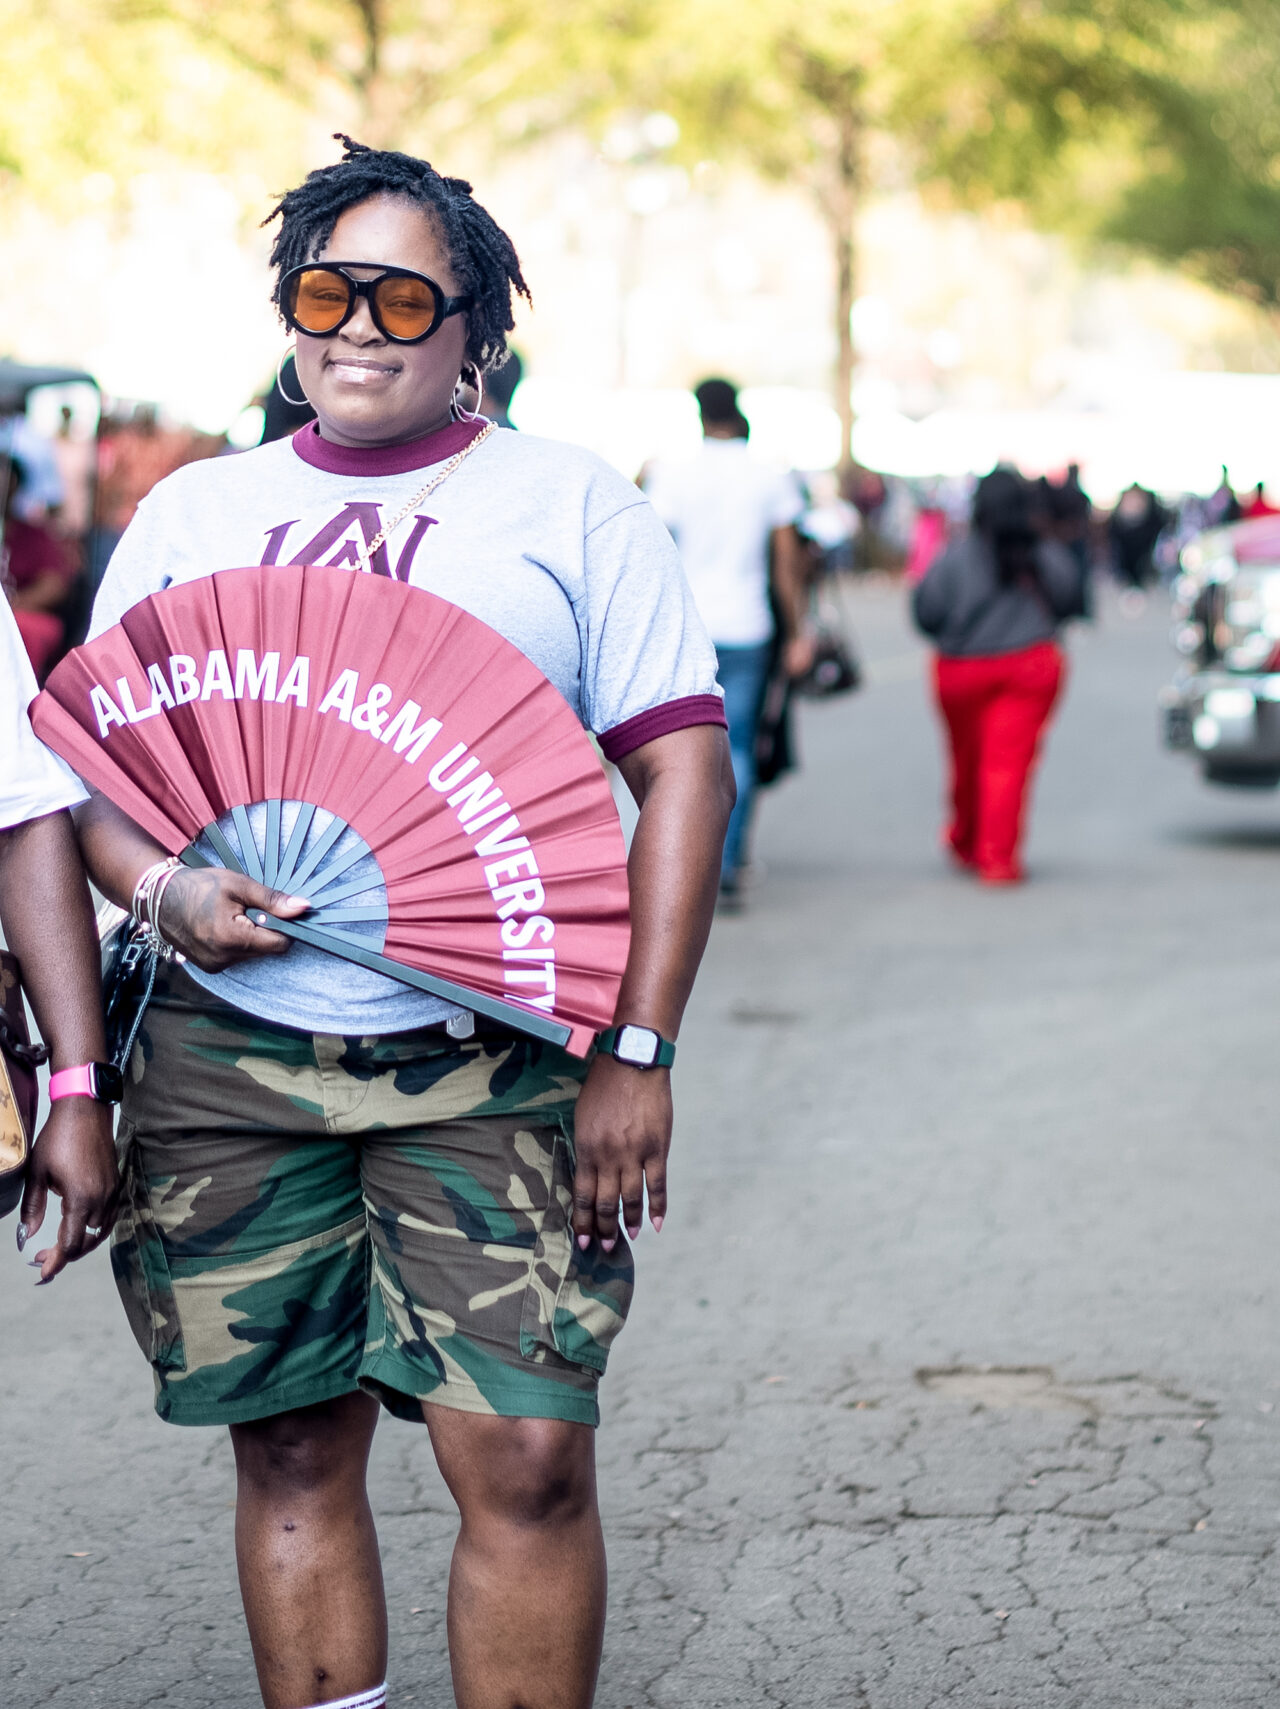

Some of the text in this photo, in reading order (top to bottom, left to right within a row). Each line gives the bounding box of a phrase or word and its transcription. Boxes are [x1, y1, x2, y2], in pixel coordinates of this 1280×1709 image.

[89, 648, 556, 1014] ALABAMA A&M UNIVERSITY
